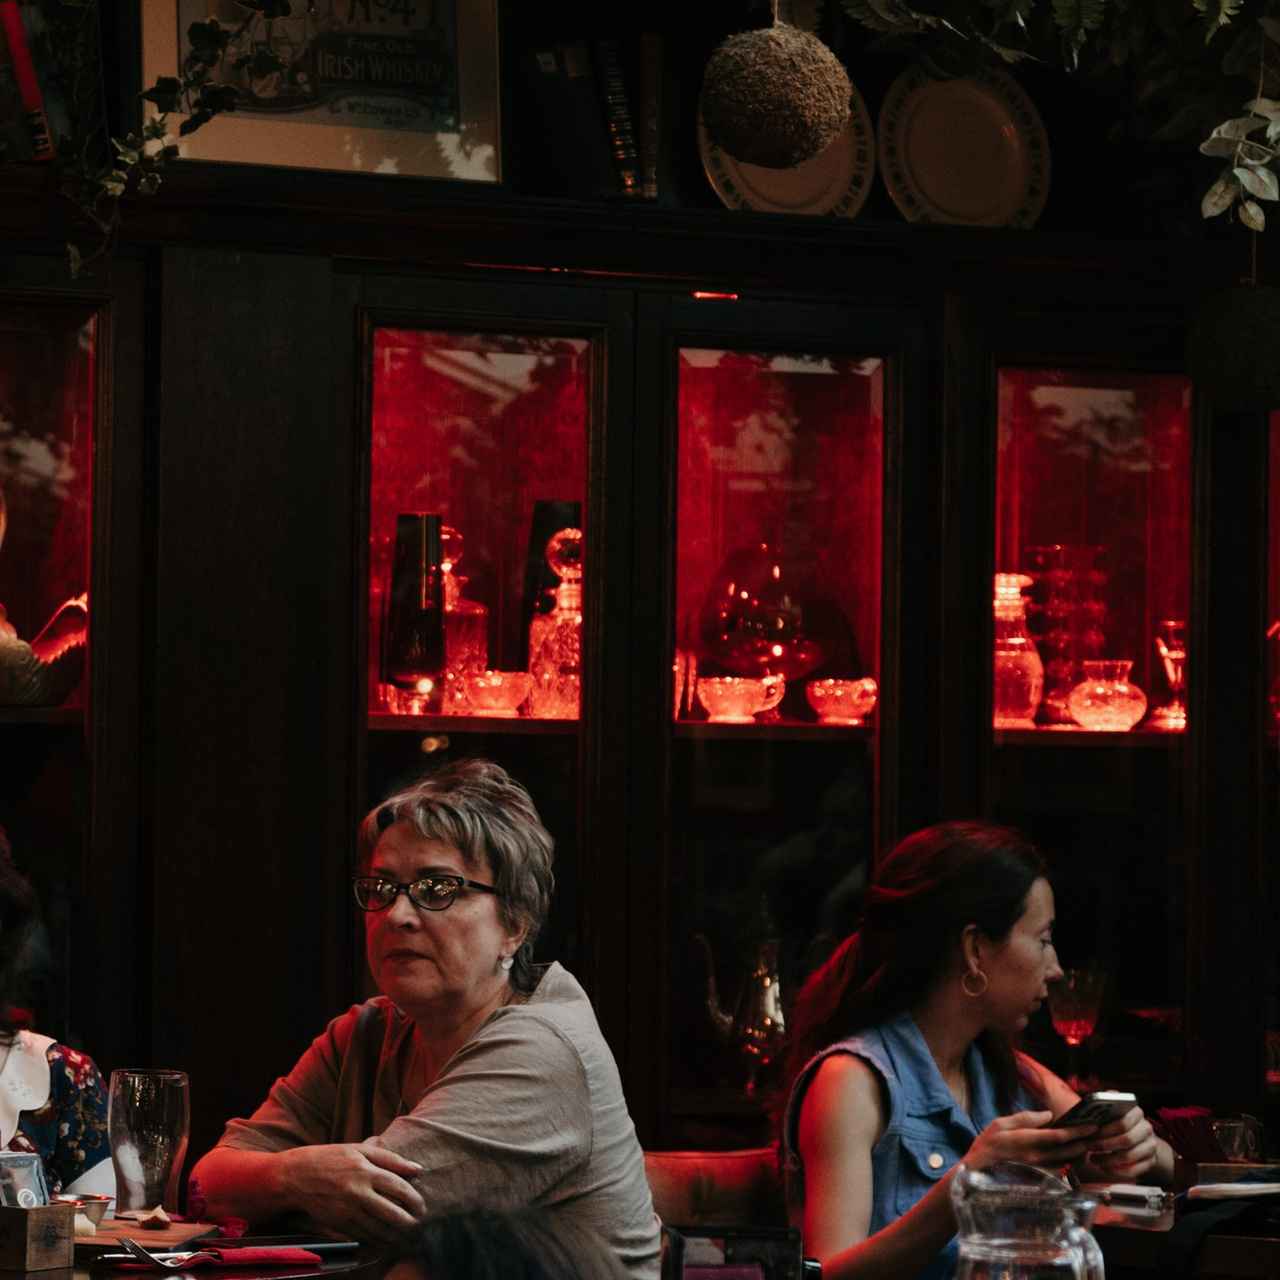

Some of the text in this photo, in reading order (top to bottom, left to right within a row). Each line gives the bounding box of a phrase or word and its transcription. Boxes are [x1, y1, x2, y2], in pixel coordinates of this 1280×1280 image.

[317, 50, 444, 85] IRISH WHISKEY
[362, 102, 402, 117] COWAN
